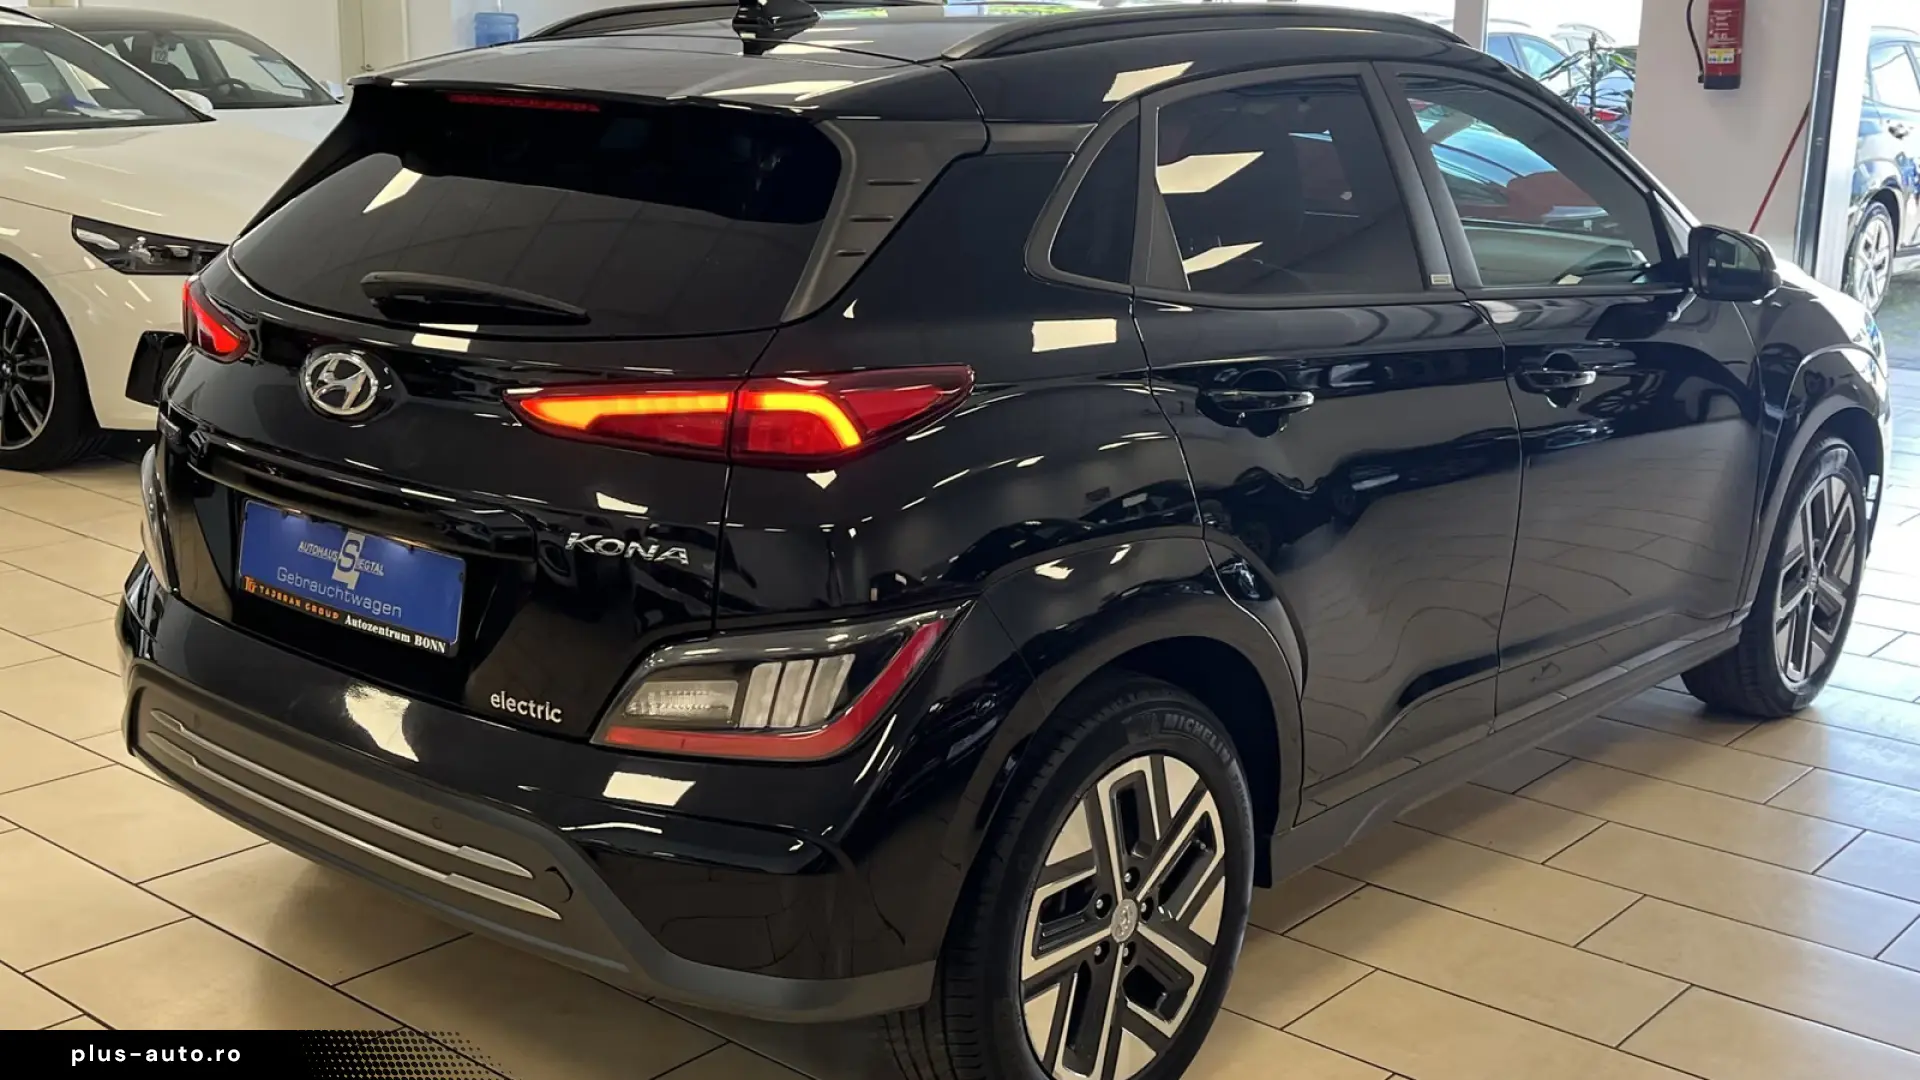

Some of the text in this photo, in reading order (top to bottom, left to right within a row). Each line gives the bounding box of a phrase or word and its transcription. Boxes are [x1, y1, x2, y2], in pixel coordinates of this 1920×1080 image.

[298, 541, 340, 563] AUTOHAUS
[565, 532, 689, 565] KONA
[276, 565, 402, 618] Gebrauchtwagen
[304, 602, 340, 620] GROUP
[344, 614, 446, 654] Autozentrum BONN
[490, 690, 562, 723] electric
[1163, 713, 1231, 766] MICHELIN
